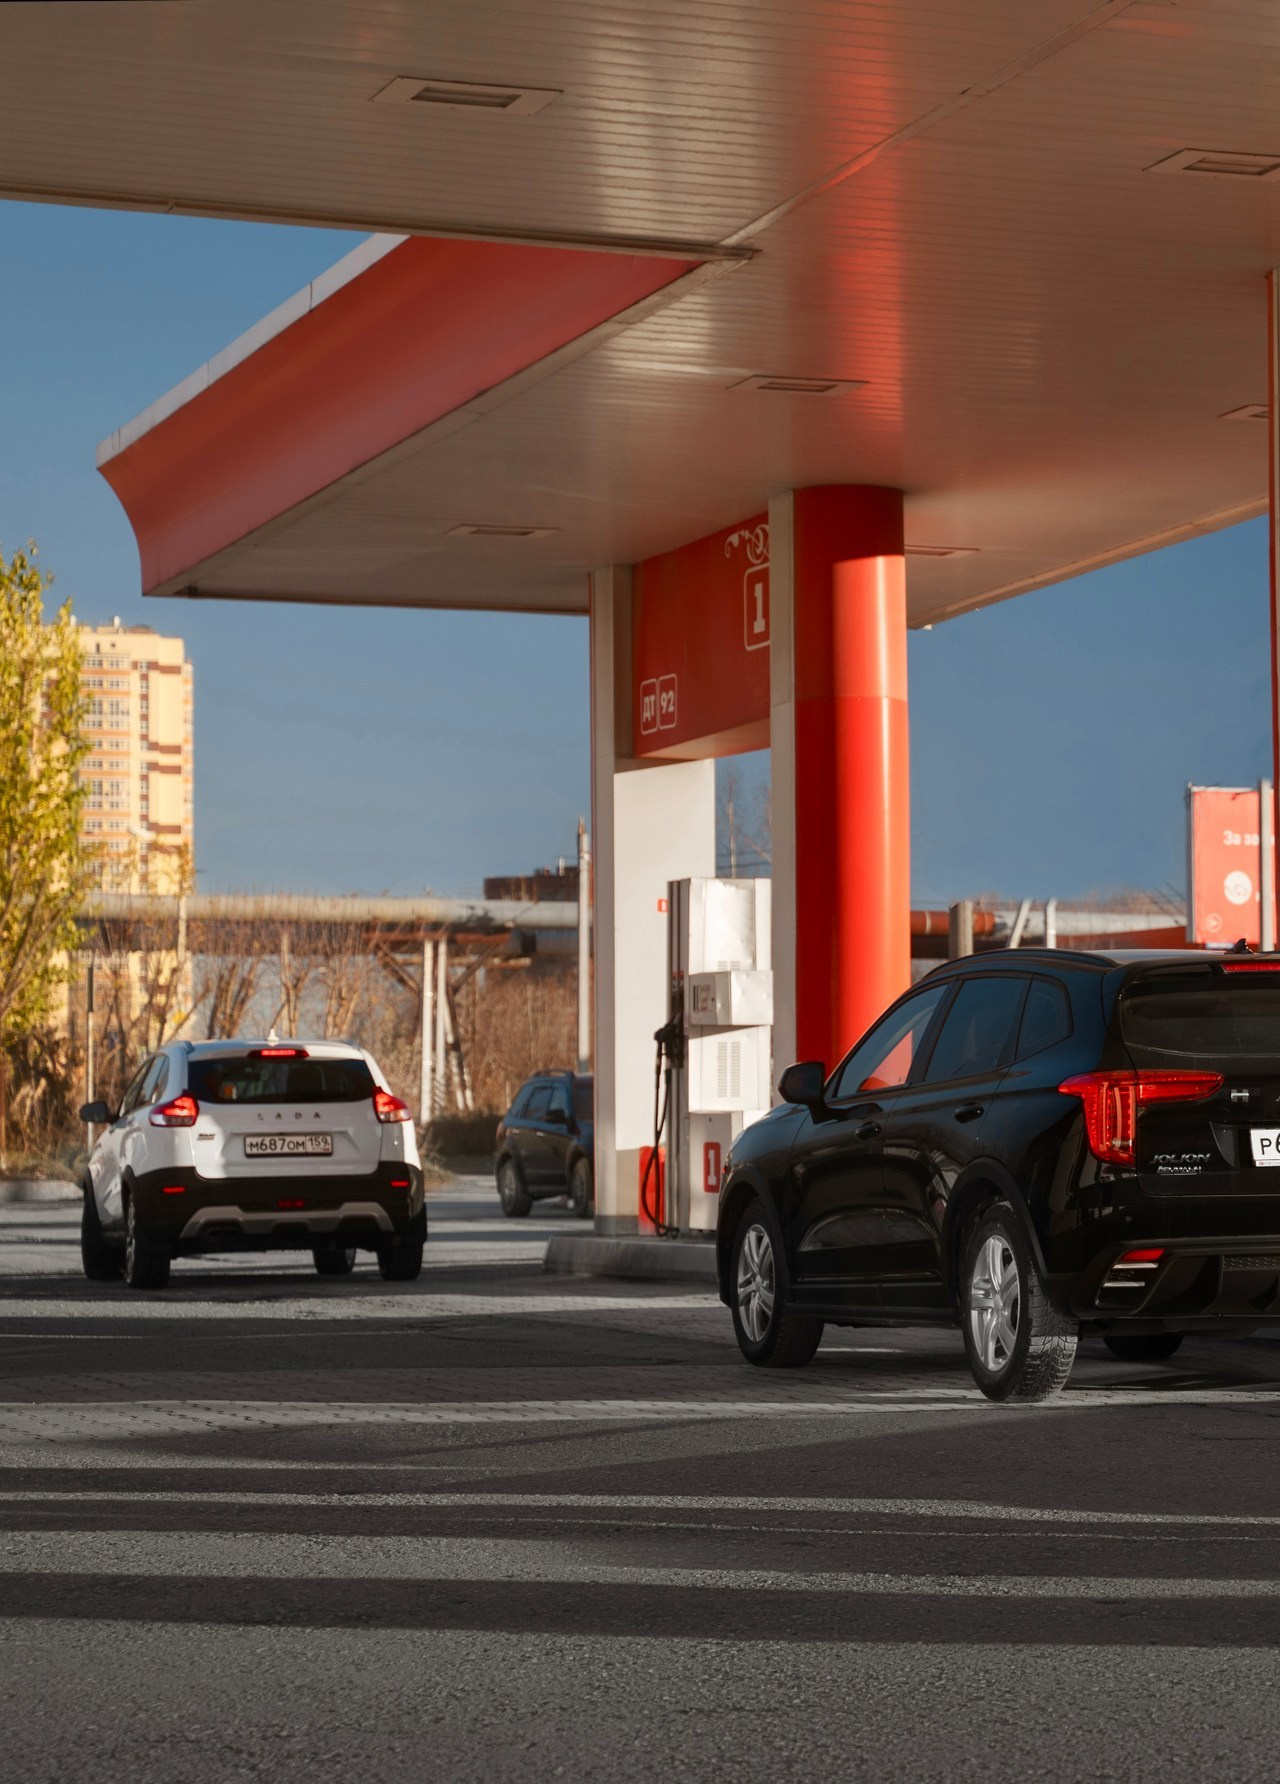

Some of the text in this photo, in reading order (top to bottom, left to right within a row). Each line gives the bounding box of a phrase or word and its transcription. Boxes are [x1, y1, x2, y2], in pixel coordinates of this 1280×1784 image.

[753, 582, 766, 634] 1
[642, 689, 675, 723] ДТ 92
[257, 1112, 321, 1121] LADA
[249, 1136, 328, 1152] М687ОМ 159
[707, 1149, 717, 1185] 1
